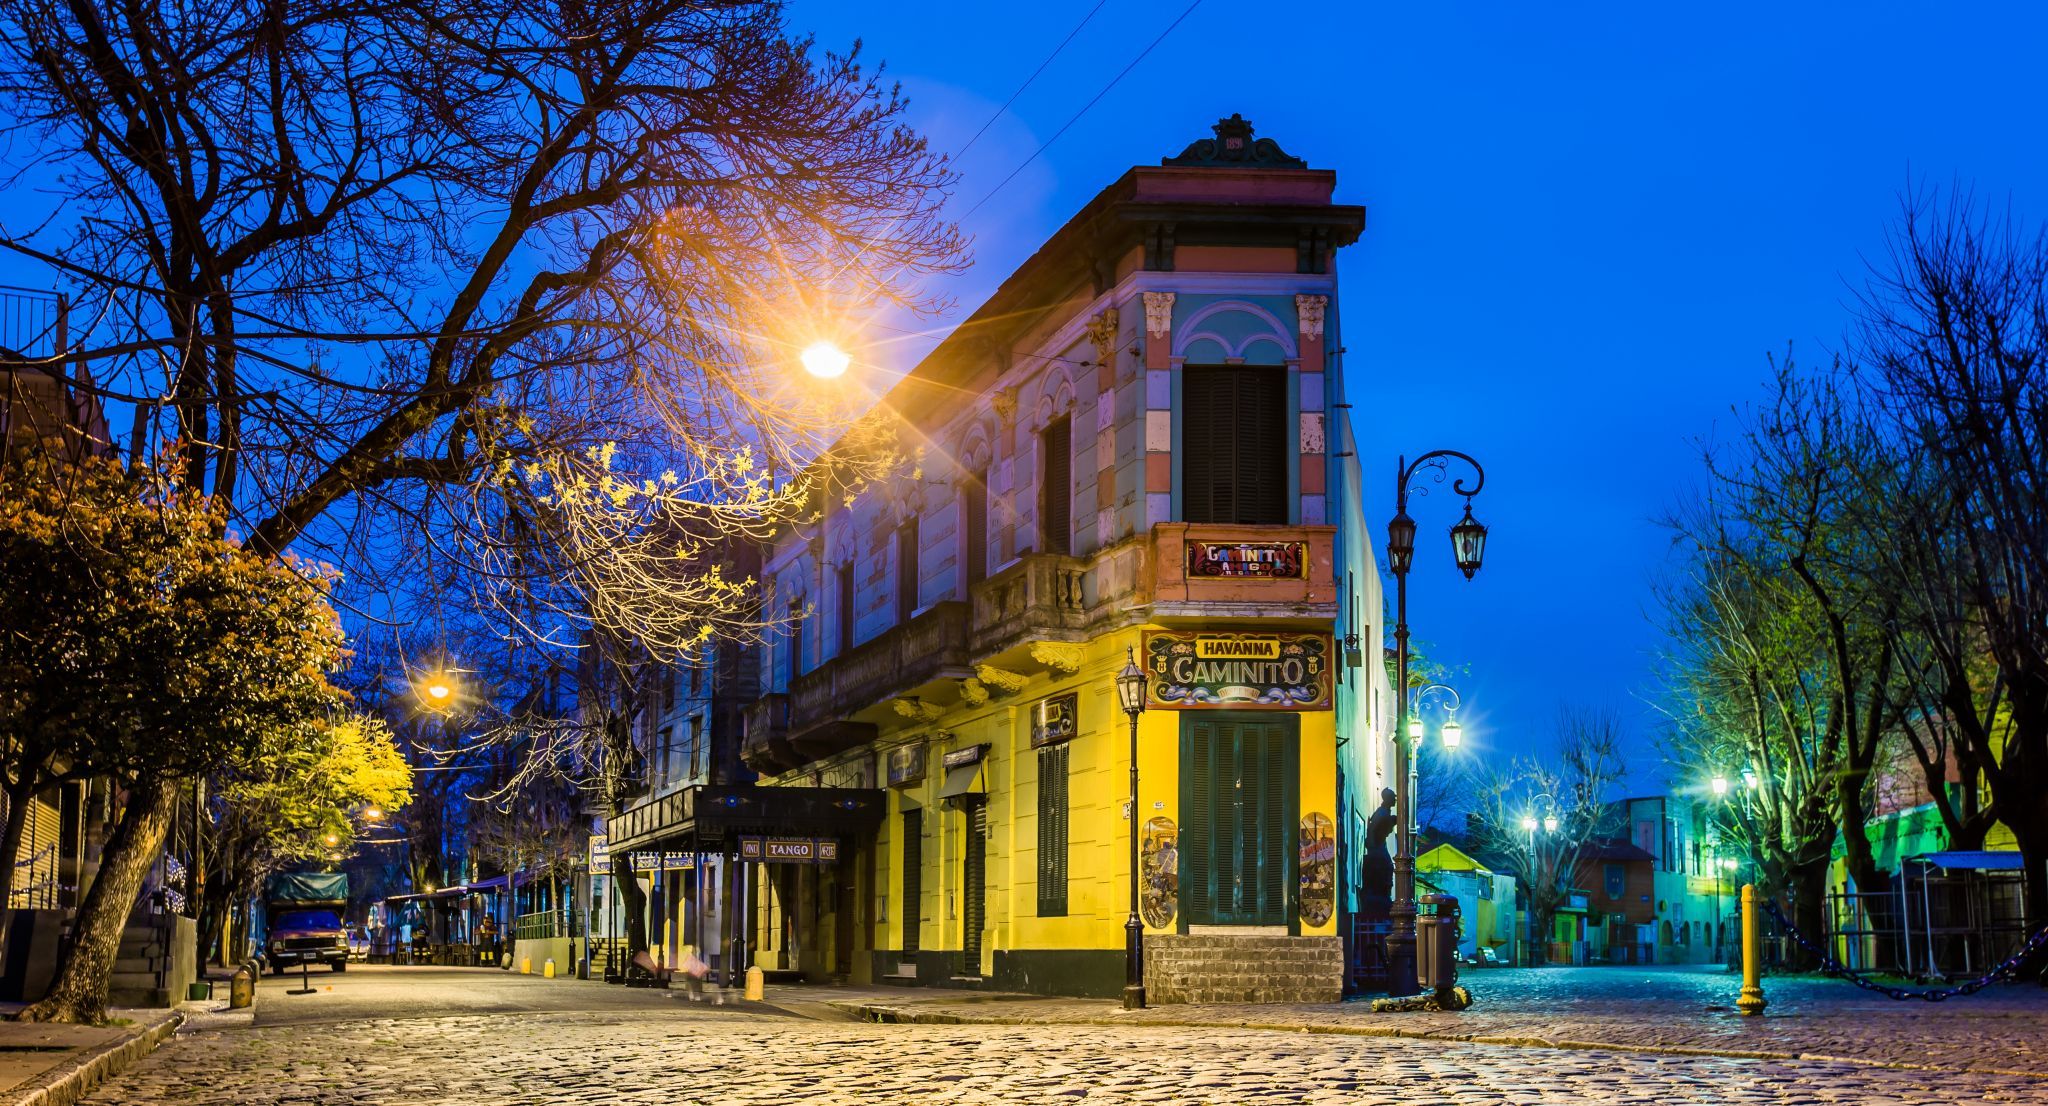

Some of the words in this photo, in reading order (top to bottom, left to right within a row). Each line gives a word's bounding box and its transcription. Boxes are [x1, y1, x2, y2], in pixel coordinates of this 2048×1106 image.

[1222, 561, 1271, 571] AMIGO
[1203, 642, 1274, 656] HAVANNA
[1173, 656, 1304, 684] CAMINITO
[770, 844, 809, 855] TANGO
[820, 845, 834, 857] ARTE
